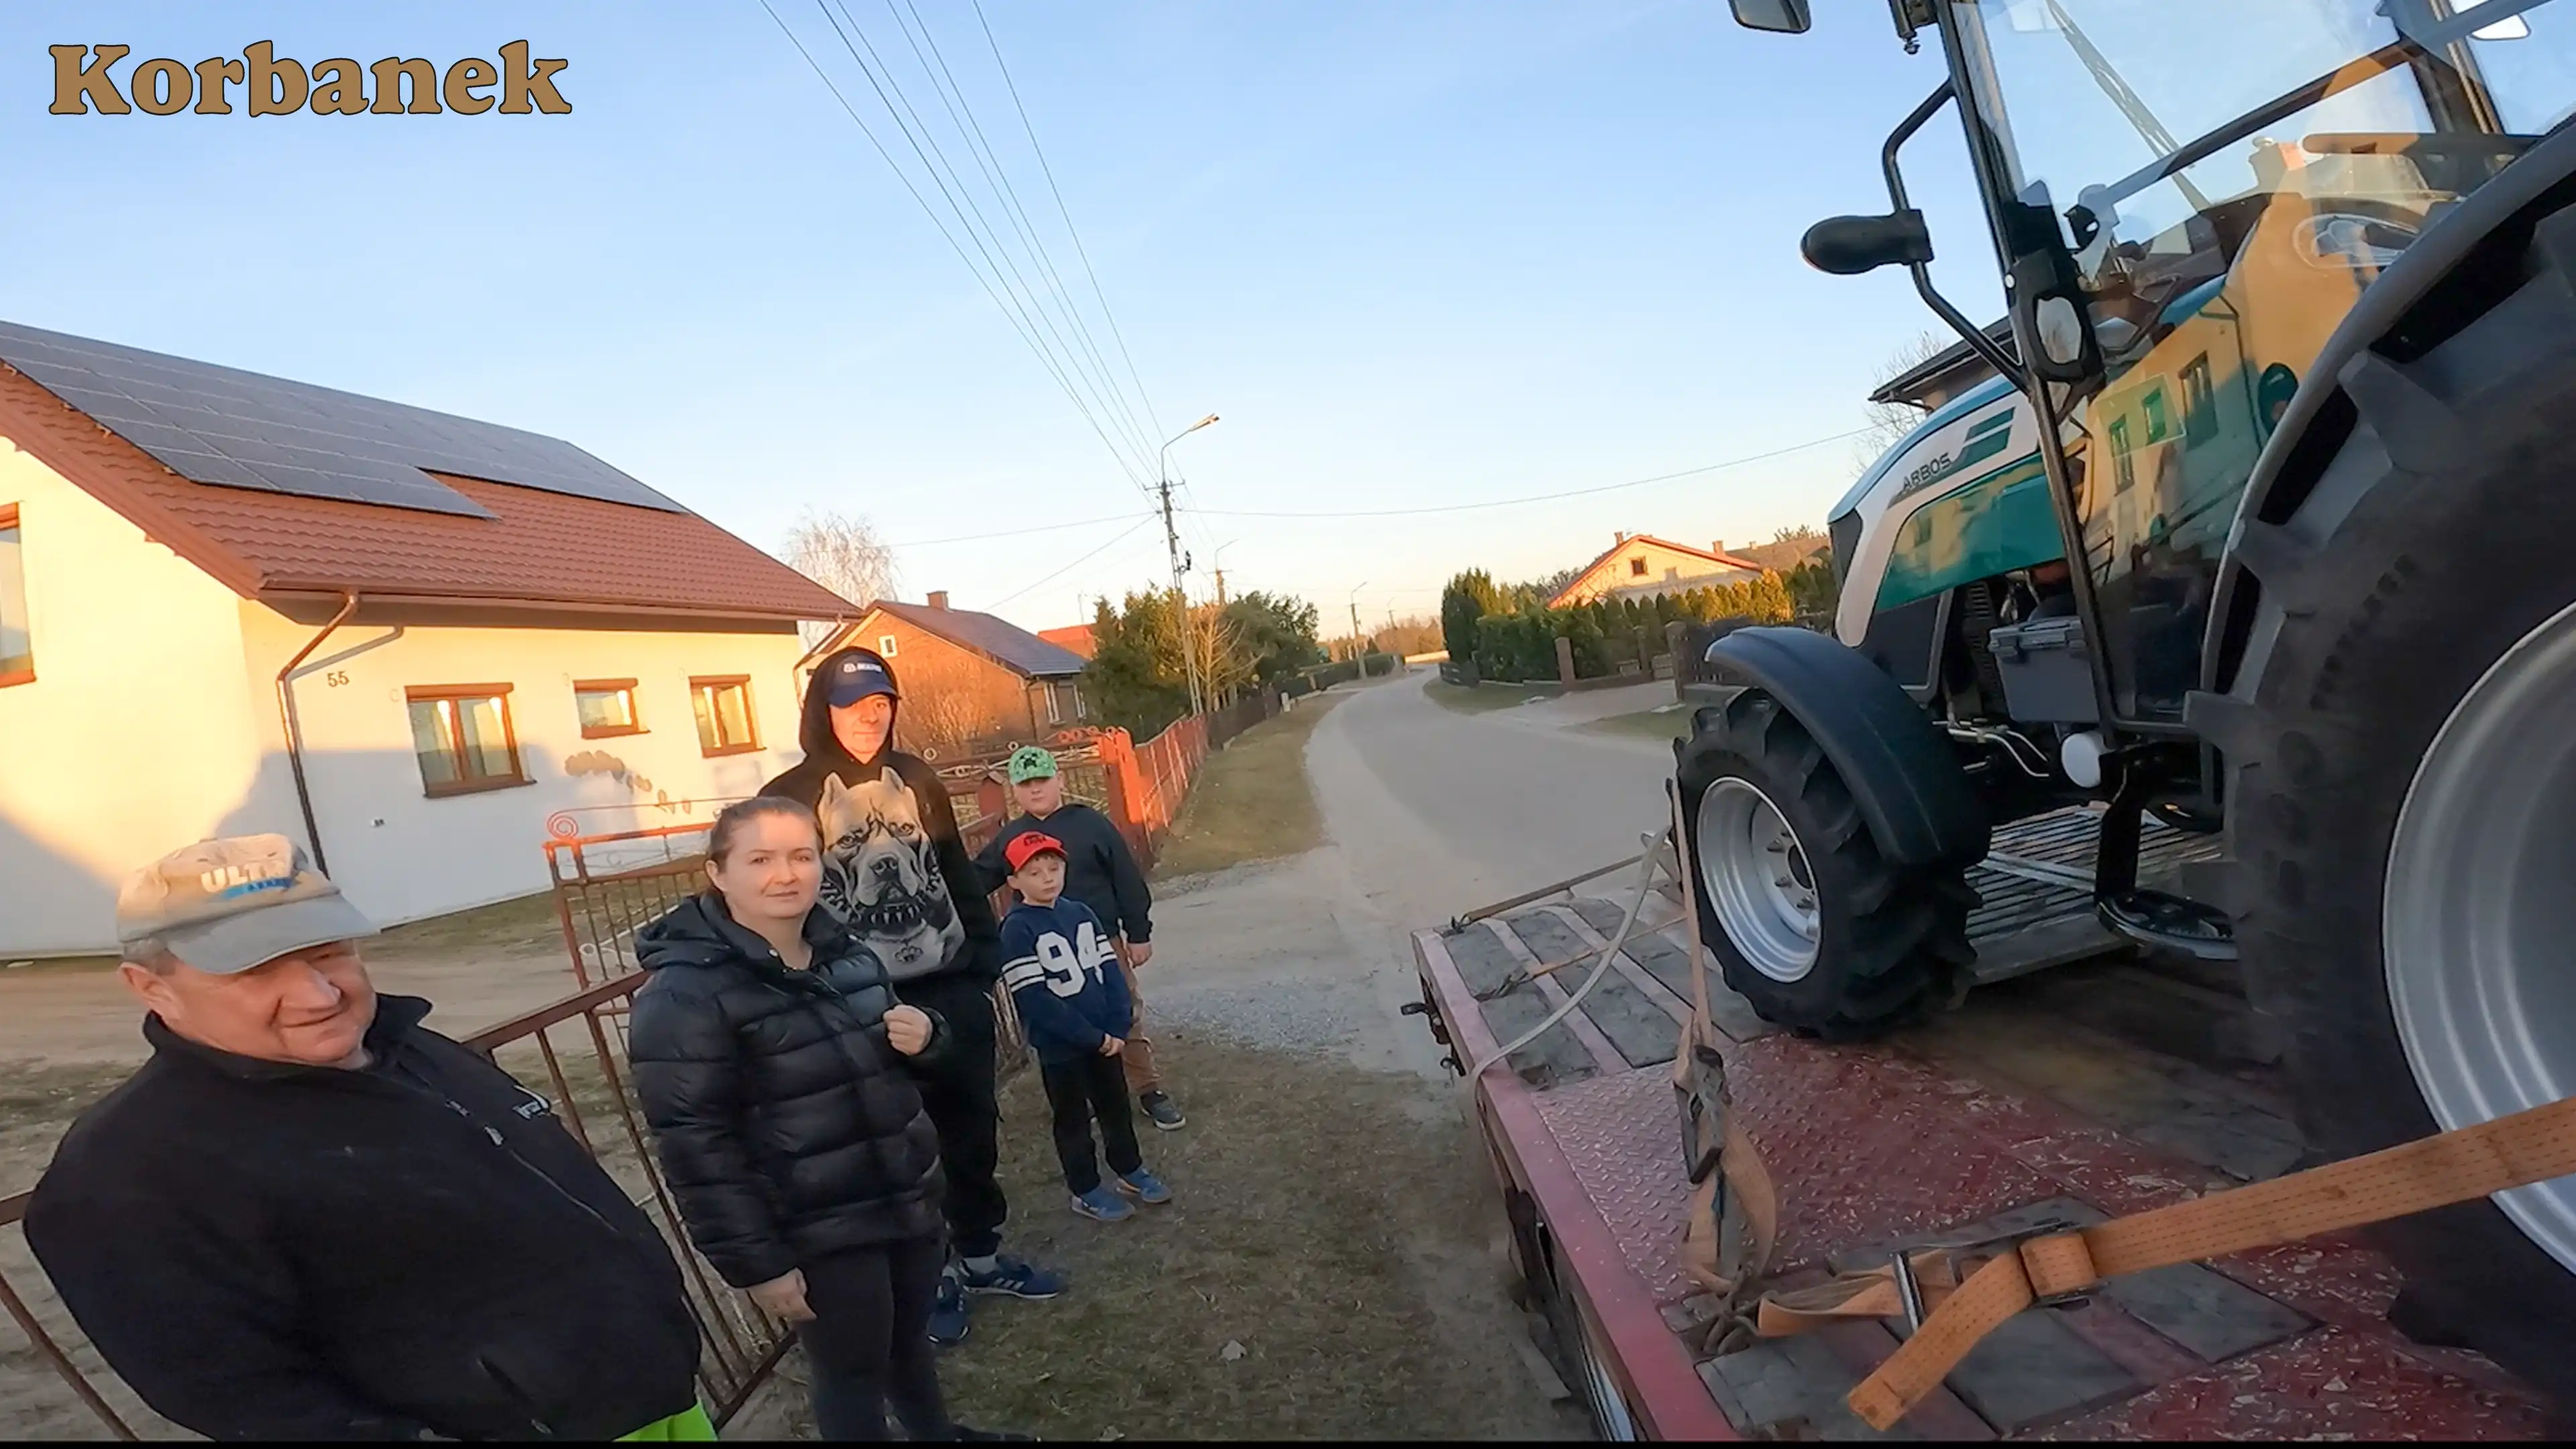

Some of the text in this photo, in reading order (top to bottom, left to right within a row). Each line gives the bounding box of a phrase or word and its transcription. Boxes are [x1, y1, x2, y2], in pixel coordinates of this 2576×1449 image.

[1903, 451, 1951, 490] ARBOS
[327, 671, 350, 688] 55
[1036, 921, 1104, 998] 94
